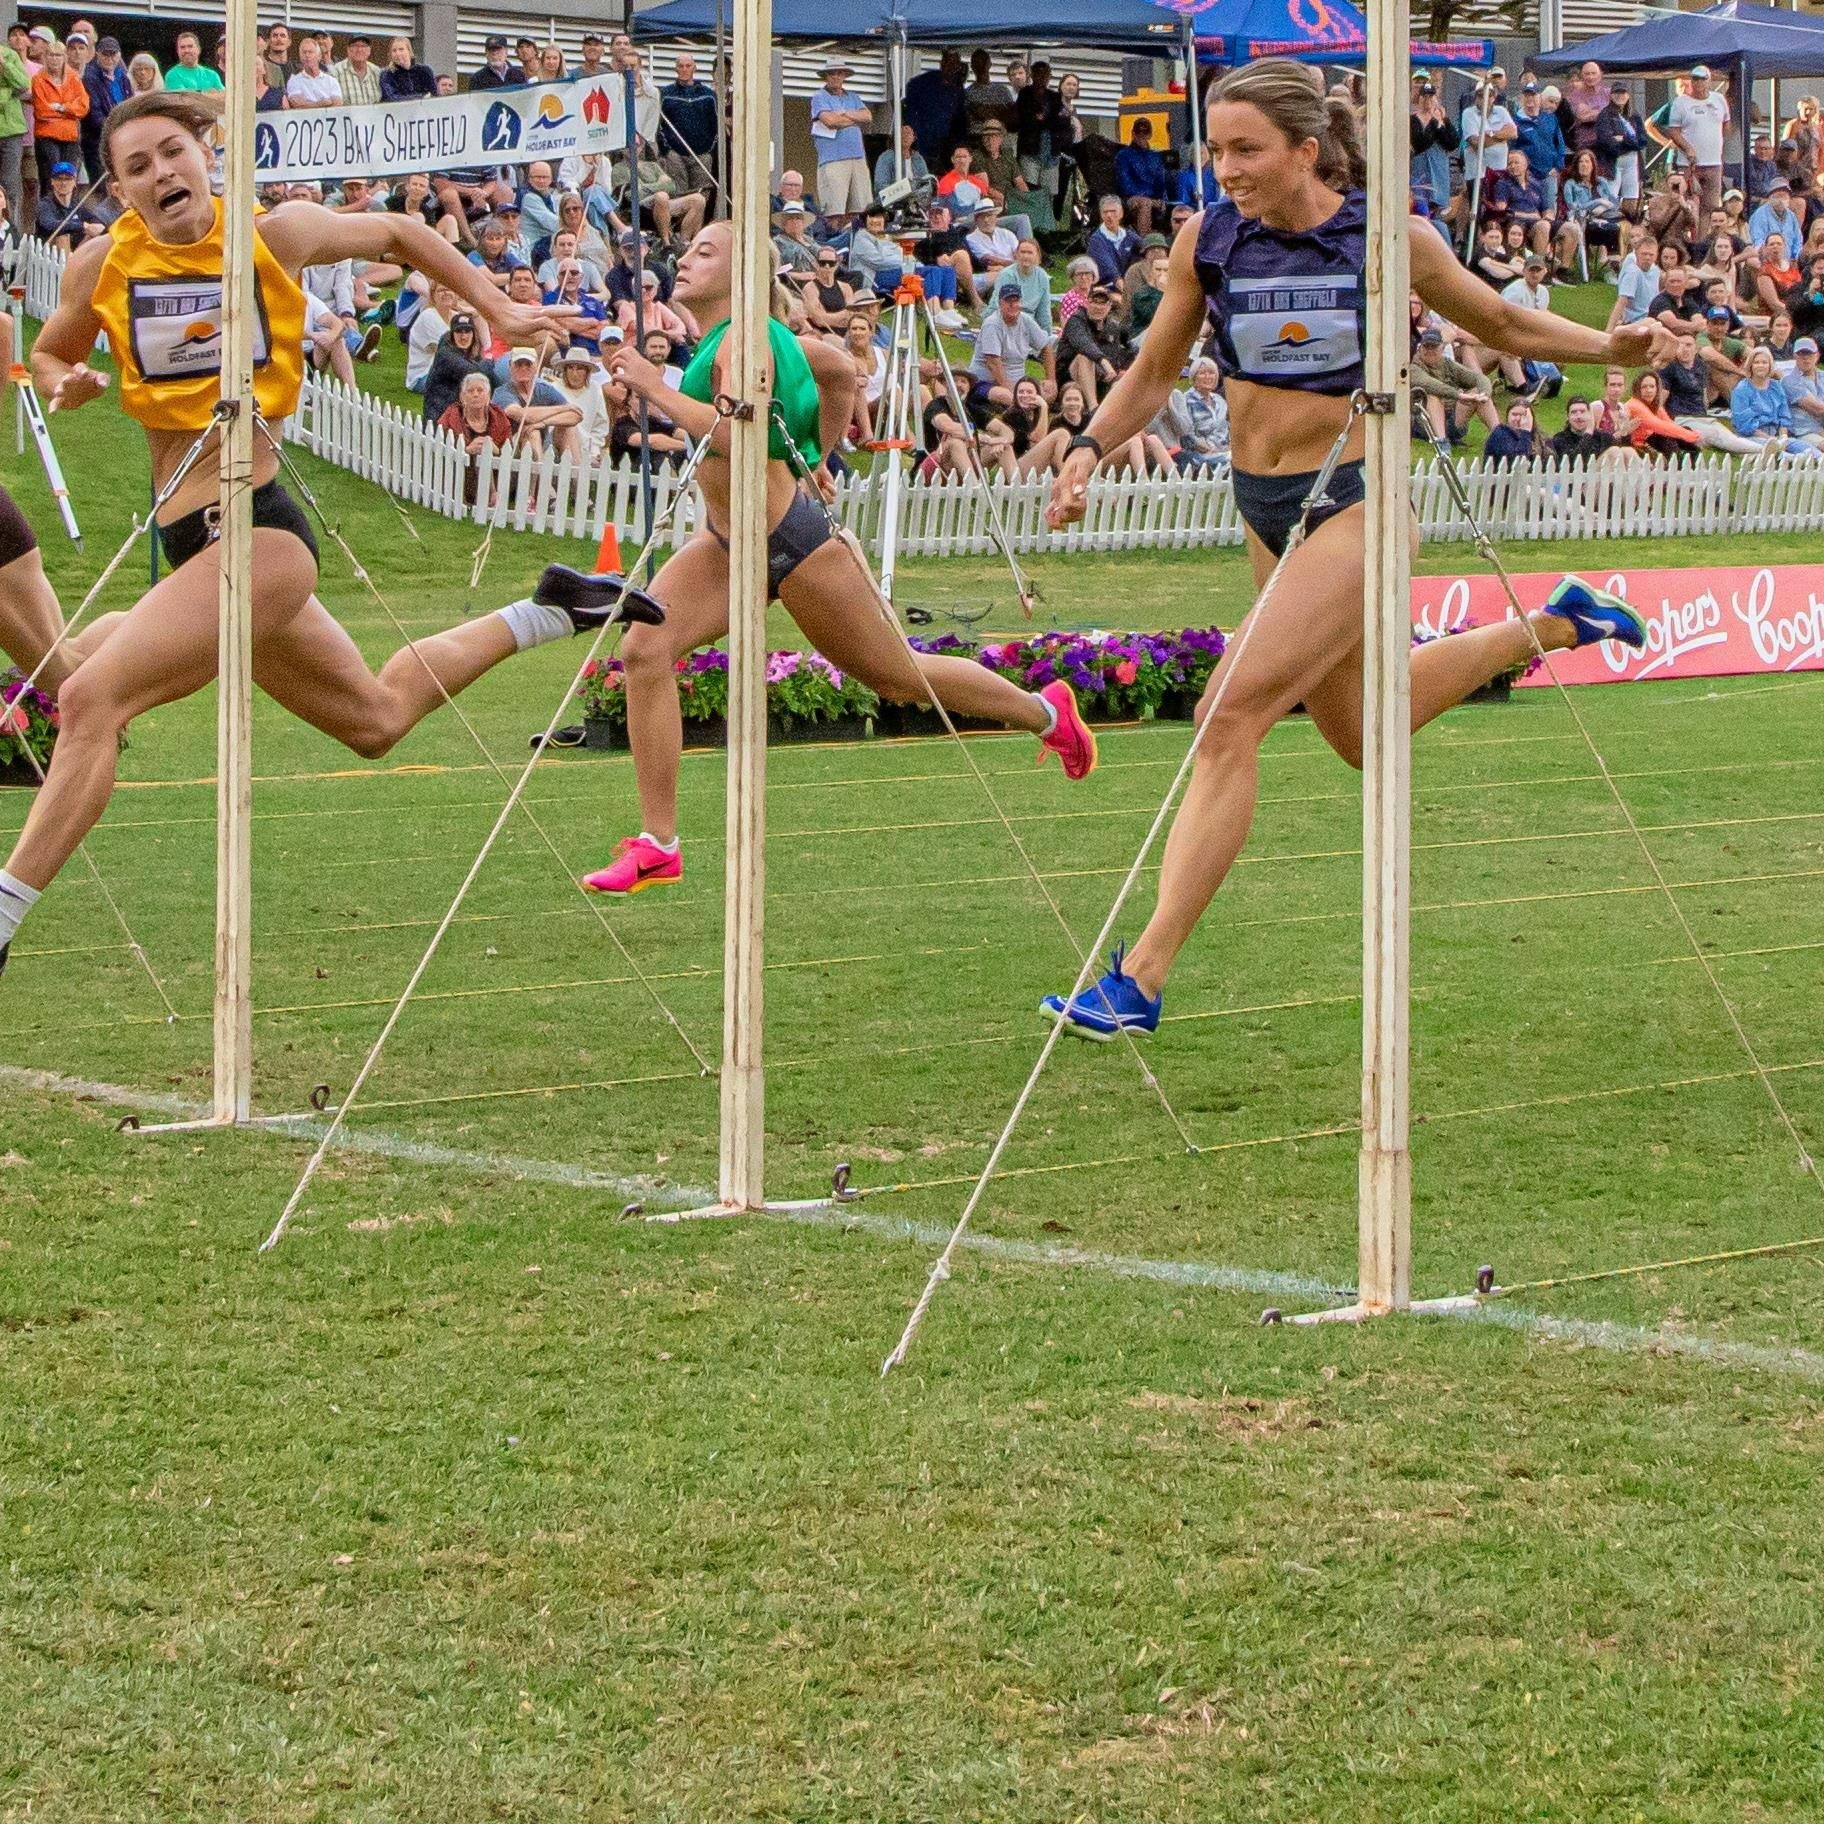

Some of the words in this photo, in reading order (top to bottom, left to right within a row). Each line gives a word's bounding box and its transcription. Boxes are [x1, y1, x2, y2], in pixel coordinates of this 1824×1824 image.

[285, 117, 337, 167] 2023
[343, 116, 375, 165] BAY
[383, 113, 467, 163] SHEFFIELD
